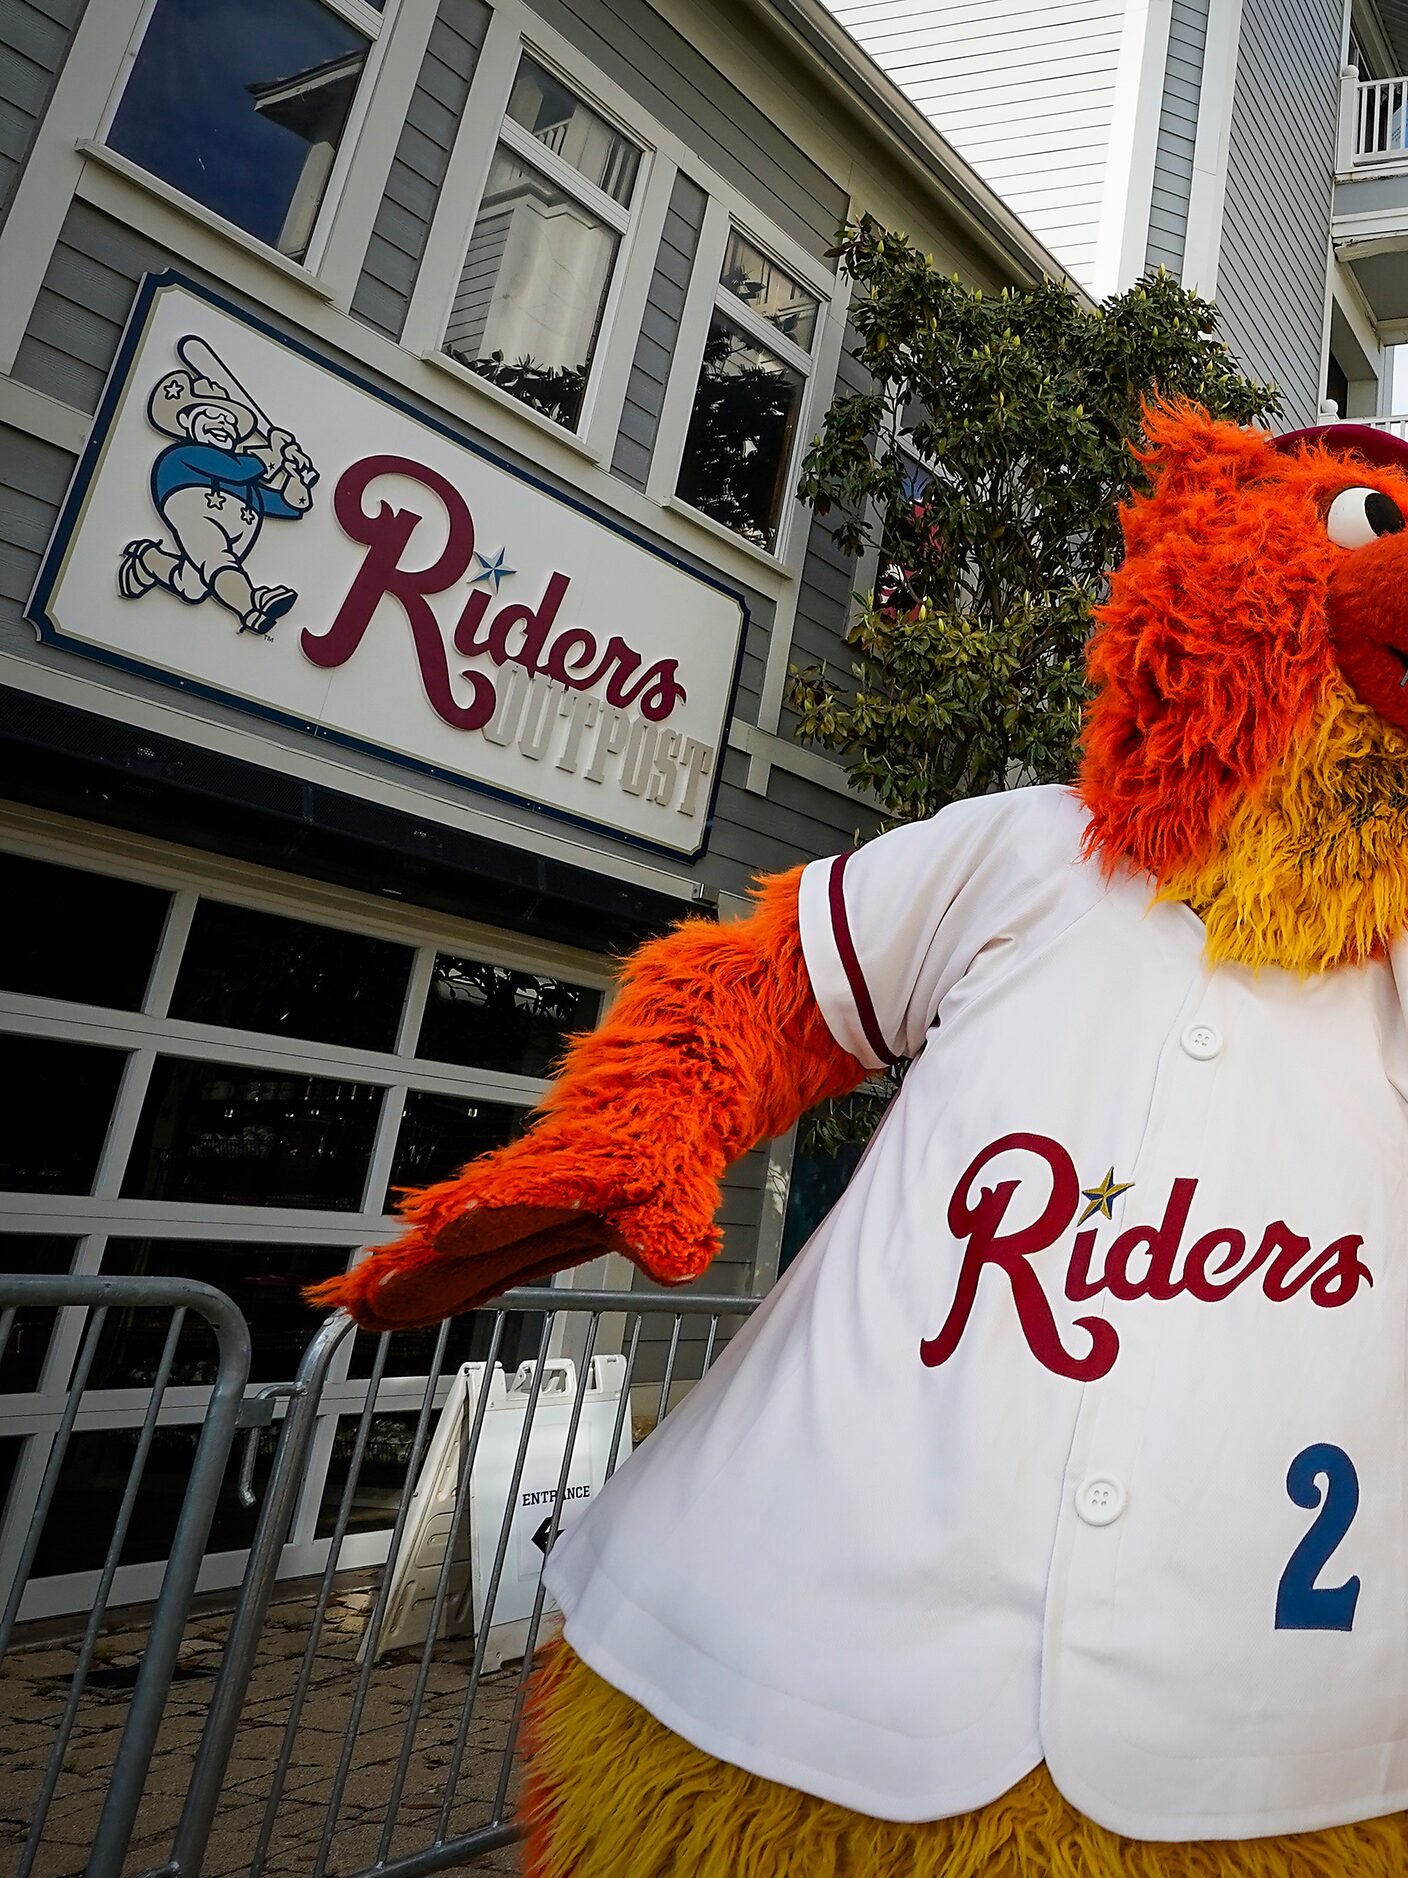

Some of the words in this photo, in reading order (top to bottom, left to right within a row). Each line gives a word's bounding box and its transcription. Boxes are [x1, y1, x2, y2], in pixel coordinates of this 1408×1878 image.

[300, 454, 687, 731] Riders
[481, 659, 714, 818] OUTPOST
[919, 1131, 1374, 1382] Riders
[522, 1485, 591, 1507] ENTRNCE
[1274, 1442, 1361, 1632] 2
